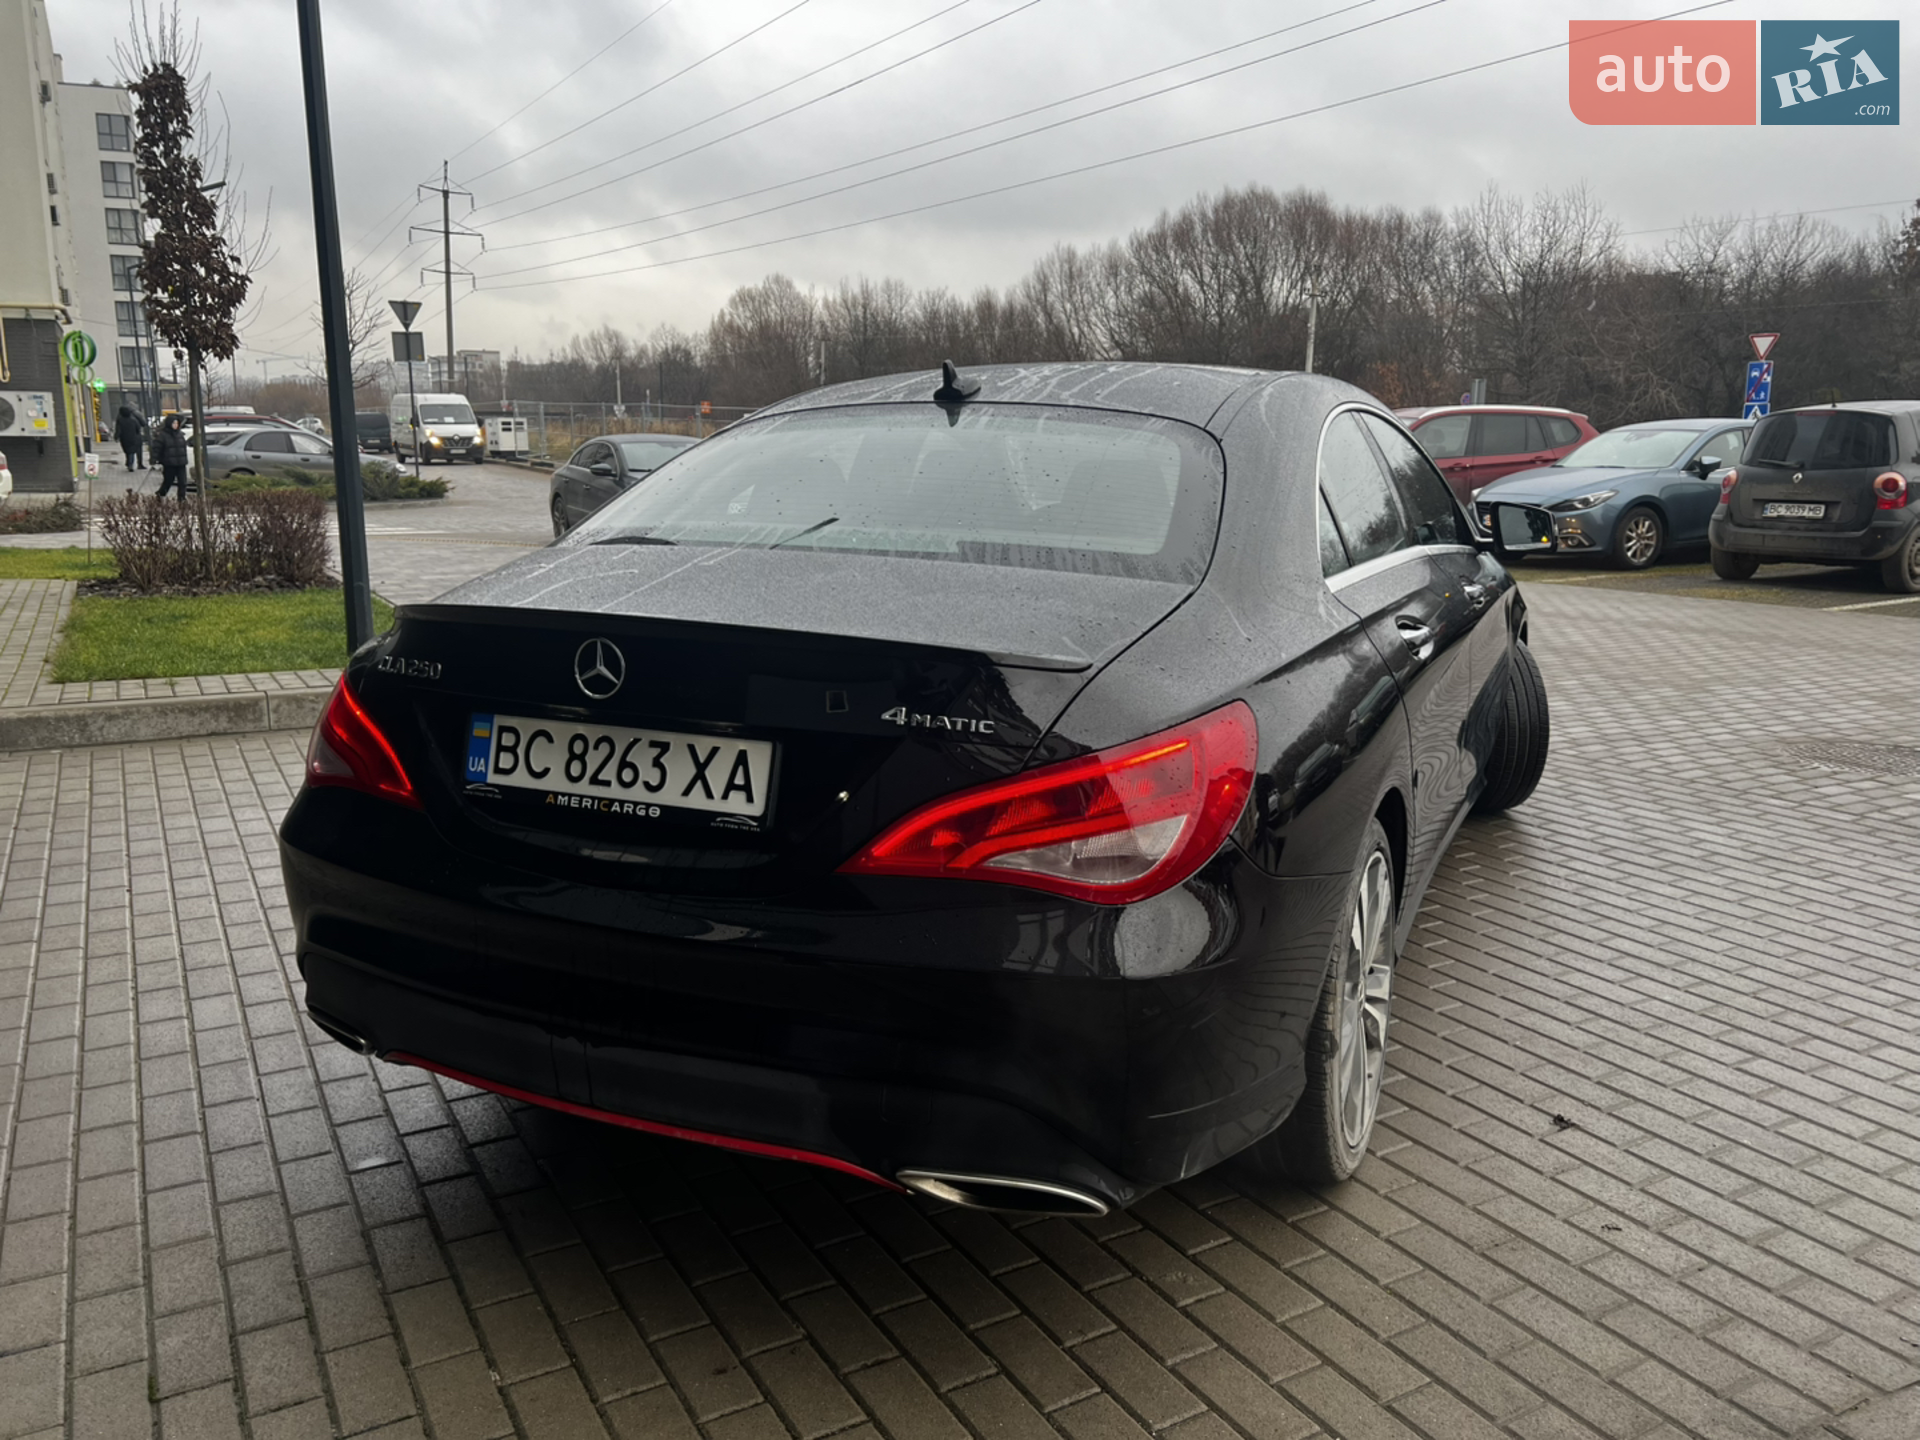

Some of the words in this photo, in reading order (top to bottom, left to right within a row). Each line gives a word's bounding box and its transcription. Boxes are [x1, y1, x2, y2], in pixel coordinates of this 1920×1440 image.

[881, 706, 995, 734] 4MATIC
[468, 756, 486, 773] UA
[493, 724, 554, 780] BC
[564, 732, 671, 794] 8263
[680, 743, 755, 804] XA
[545, 793, 661, 817] AMERICARGO
